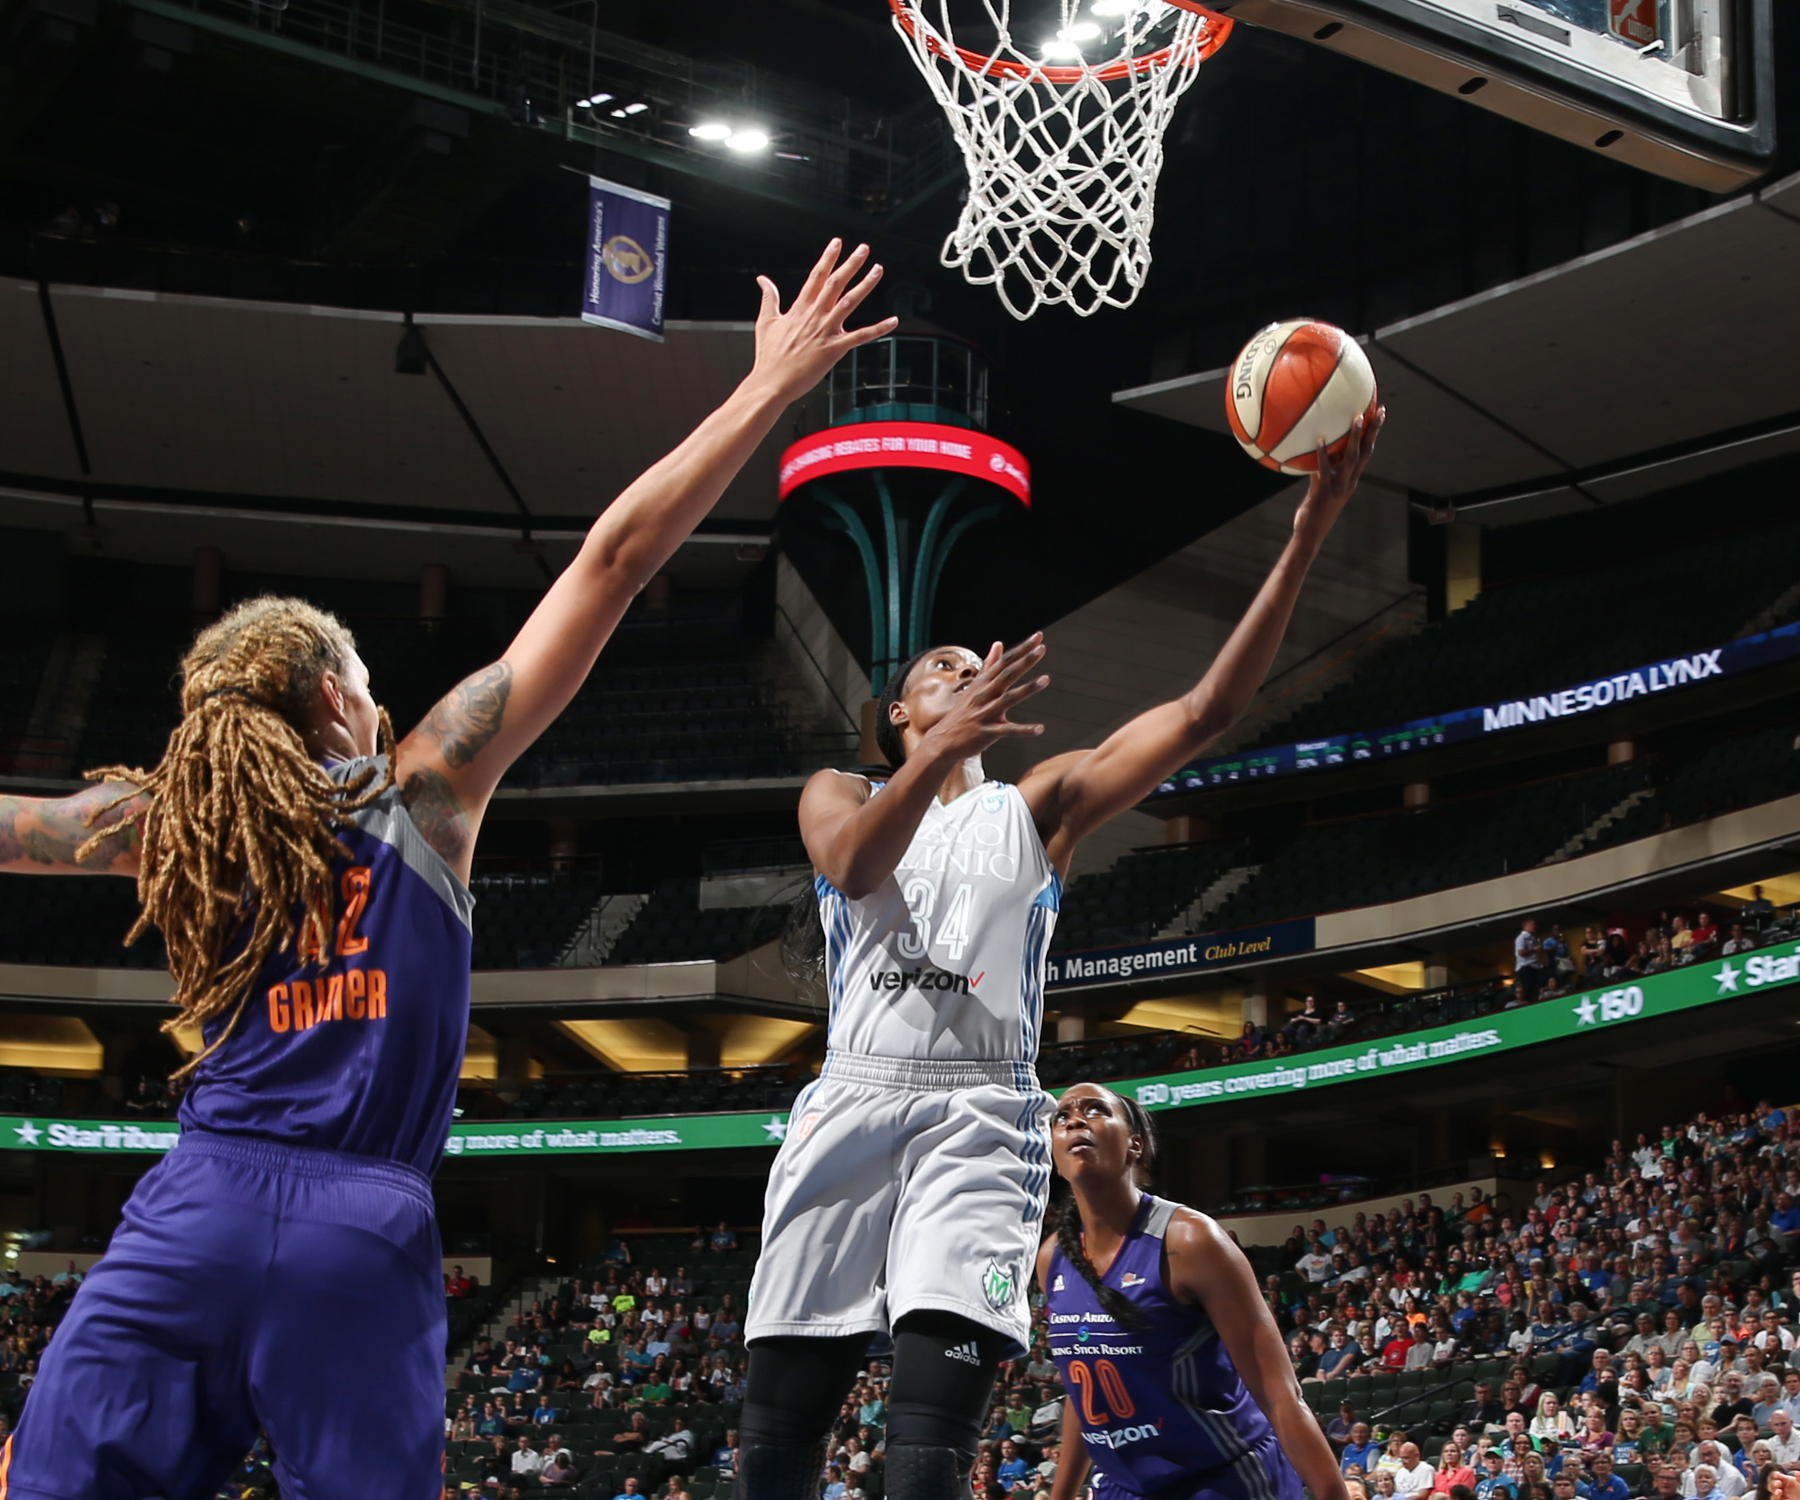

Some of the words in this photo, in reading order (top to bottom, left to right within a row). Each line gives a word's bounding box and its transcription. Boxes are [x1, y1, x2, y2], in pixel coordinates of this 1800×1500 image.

[592, 201, 604, 253] America's
[655, 216, 666, 251] Veterans
[589, 254, 605, 304] Honoring
[654, 251, 665, 291] Wounded
[652, 291, 664, 325] Combat
[1483, 672, 1648, 731] MINNESOTA
[1649, 649, 1723, 691] LYNX
[916, 821, 1005, 847] AYO
[897, 877, 973, 961] 34
[1065, 943, 1197, 979] Management
[1205, 945, 1236, 961] Club
[1238, 937, 1271, 954] Level
[870, 967, 970, 995] verizon
[1599, 985, 1644, 1021] 150
[1169, 1080, 1224, 1105] years
[1224, 1066, 1308, 1088] covering
[1307, 1058, 1356, 1080] more
[1356, 1048, 1379, 1071] of
[1378, 1043, 1428, 1067] what
[1428, 1029, 1502, 1058] matters.
[465, 1134, 520, 1149] more
[520, 1129, 545, 1149] of
[545, 1128, 599, 1148] what
[600, 1128, 682, 1147] matters.
[944, 1348, 981, 1366] adidas
[1068, 1358, 1136, 1426] 20
